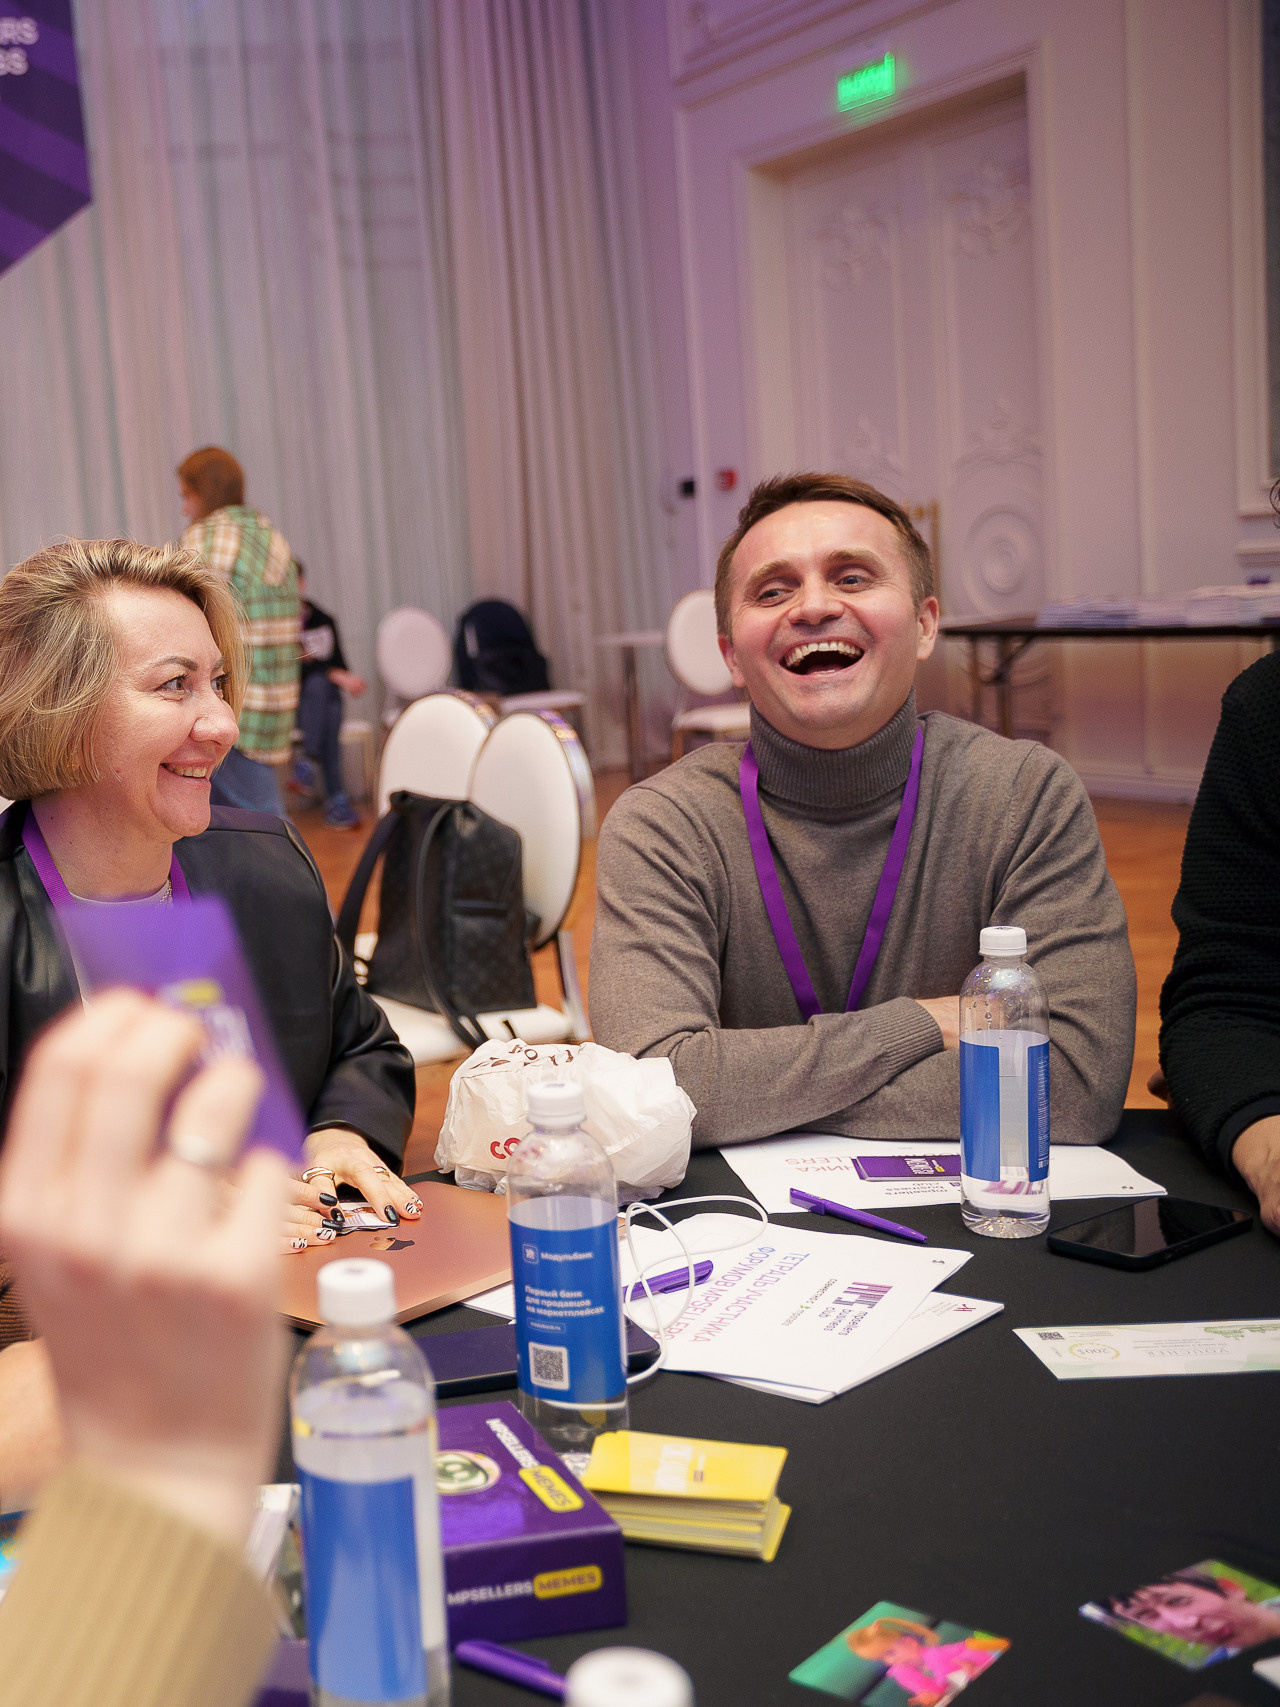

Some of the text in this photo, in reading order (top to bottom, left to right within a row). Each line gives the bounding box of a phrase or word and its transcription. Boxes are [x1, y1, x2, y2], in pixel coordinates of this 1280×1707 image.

[540, 1252, 593, 1262] Модульбанк
[715, 1246, 776, 1289] ФОРУМОВ
[524, 1285, 583, 1299] Первый банк
[525, 1296, 591, 1308] для продавцов
[688, 1252, 810, 1342] ТЕТРАДЬ УЧАСТНИКА
[526, 1305, 605, 1317] на маркетплейсах
[486, 1418, 573, 1508] MPSELLERS MEMES
[447, 1571, 597, 1606] MPSELLERS MEMES
